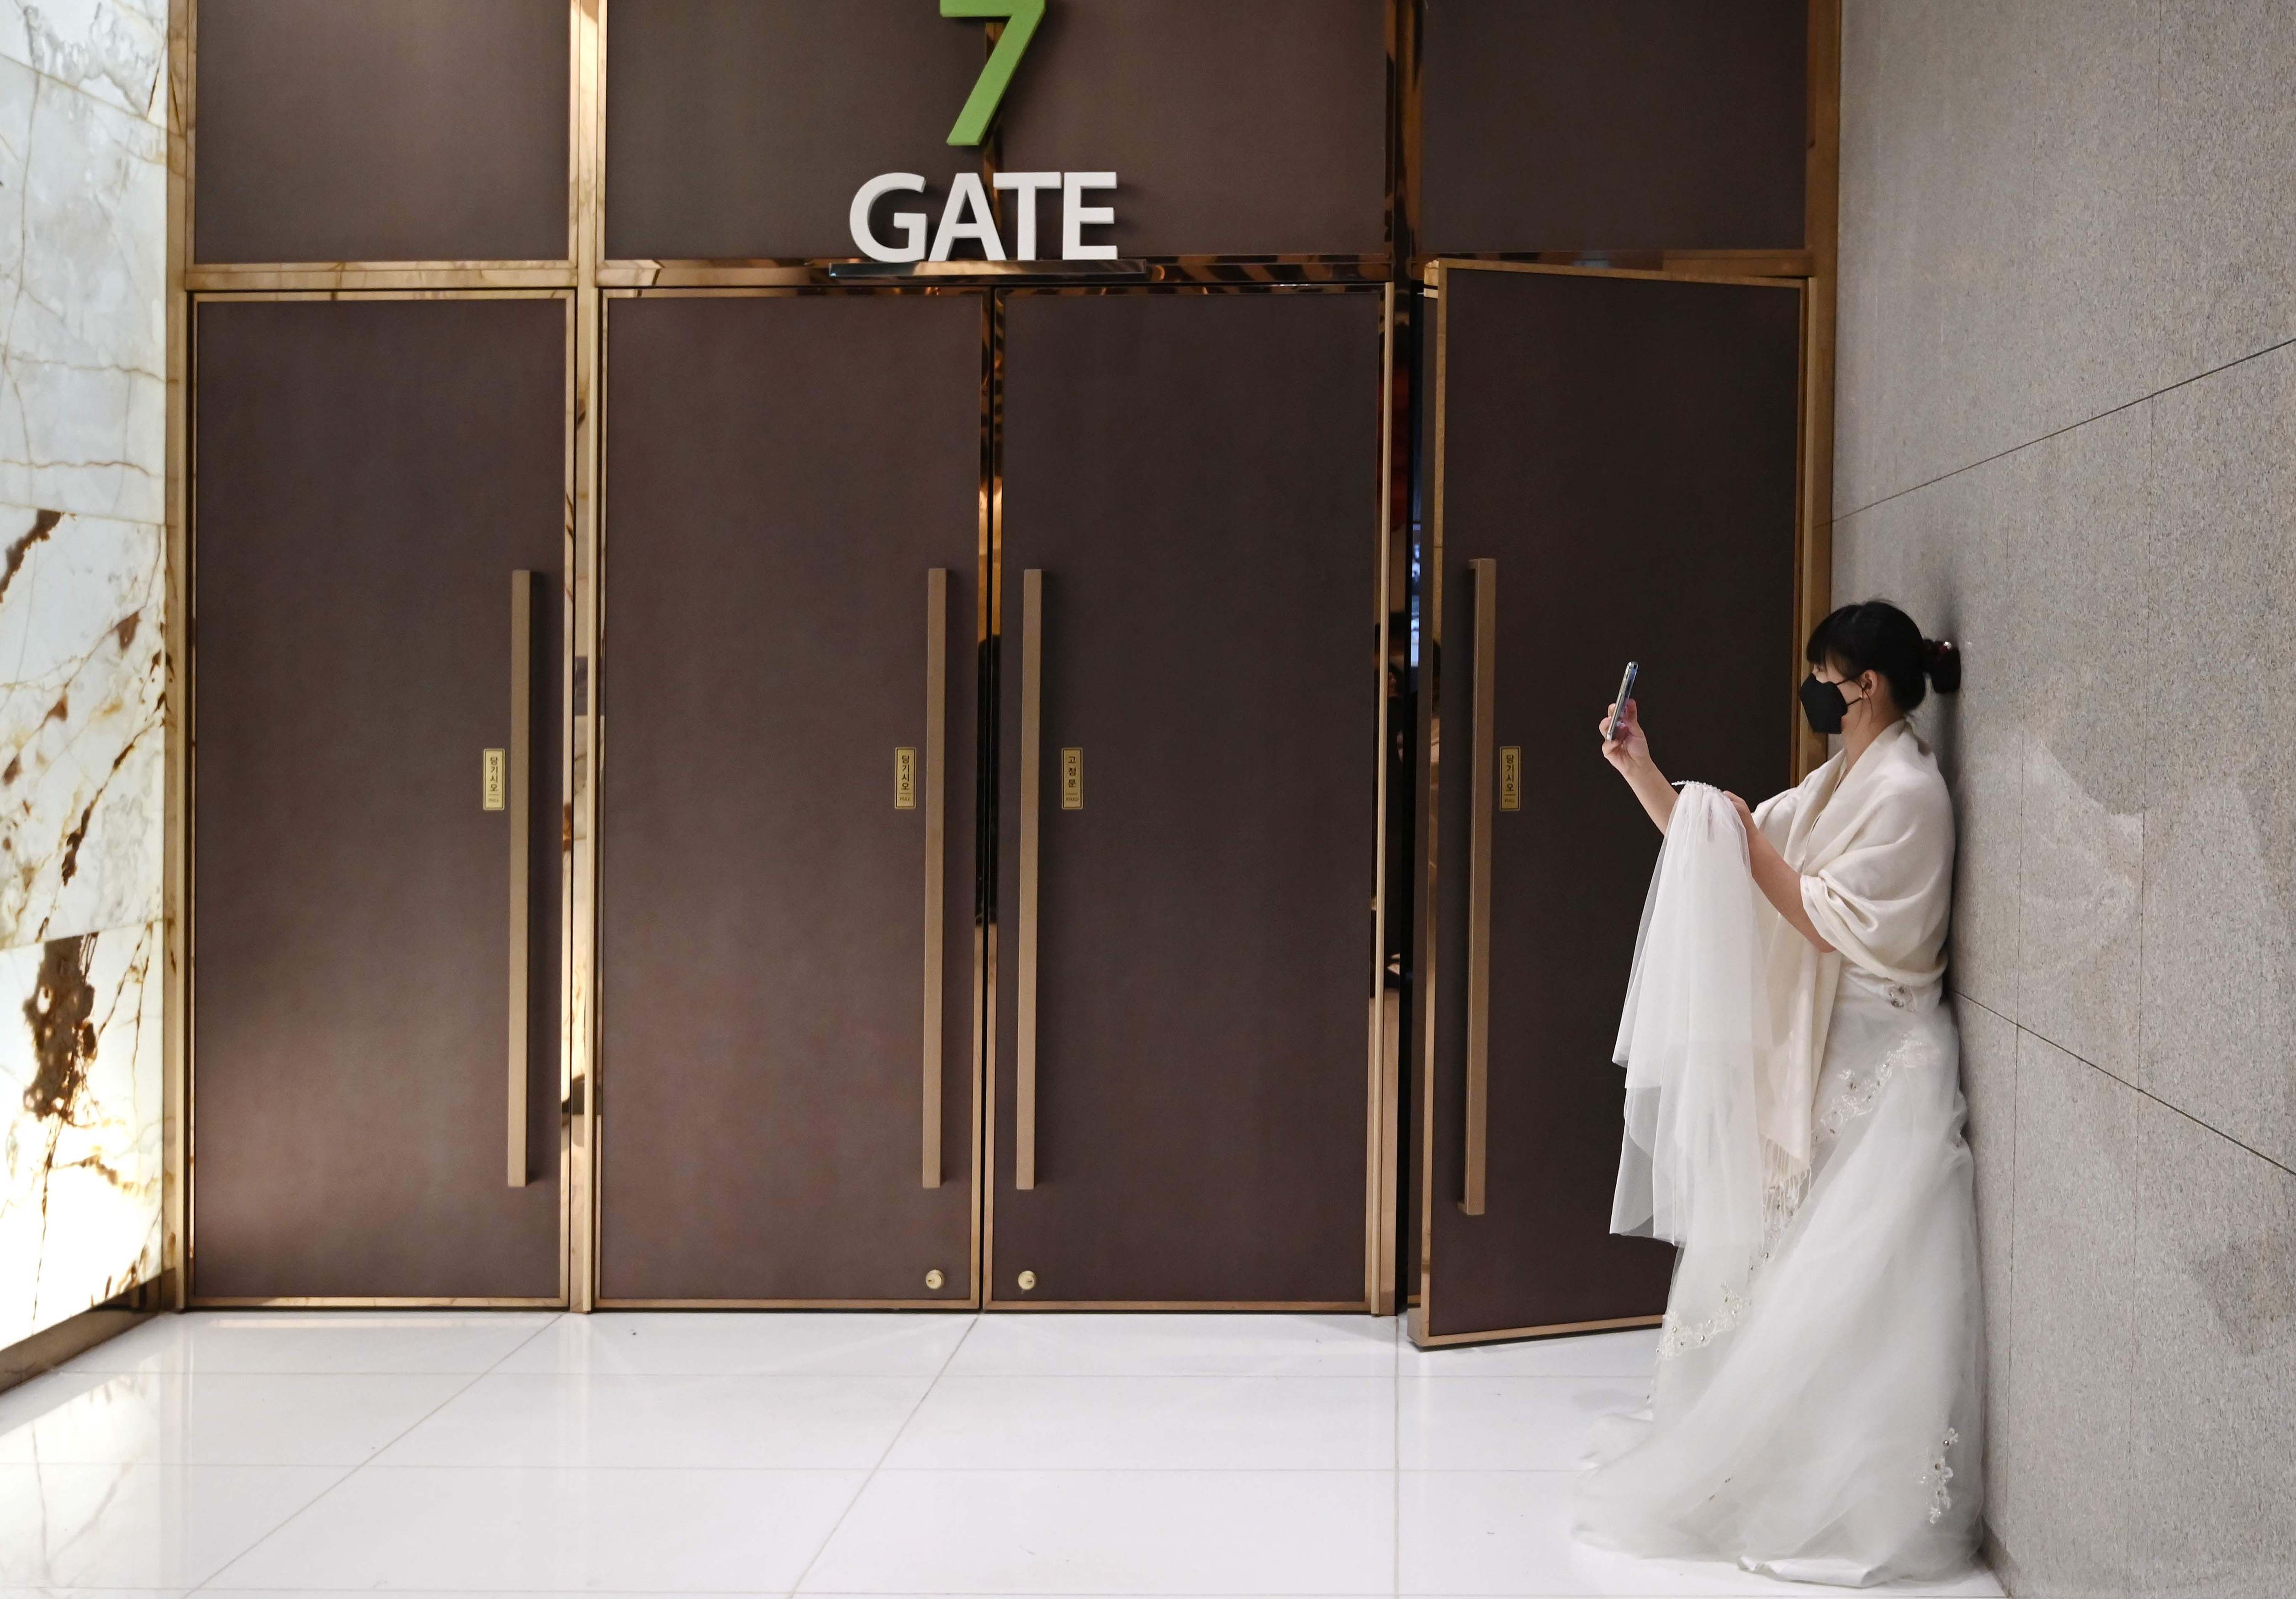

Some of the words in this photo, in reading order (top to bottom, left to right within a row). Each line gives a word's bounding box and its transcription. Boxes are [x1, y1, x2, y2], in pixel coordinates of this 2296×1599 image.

[939, 0, 1047, 146] 7
[849, 172, 1118, 263] GATE
[490, 756, 498, 792] 당기시오
[901, 755, 910, 790] 당기시오
[1068, 756, 1077, 788] 고정문
[1506, 755, 1514, 792] 당기시오
